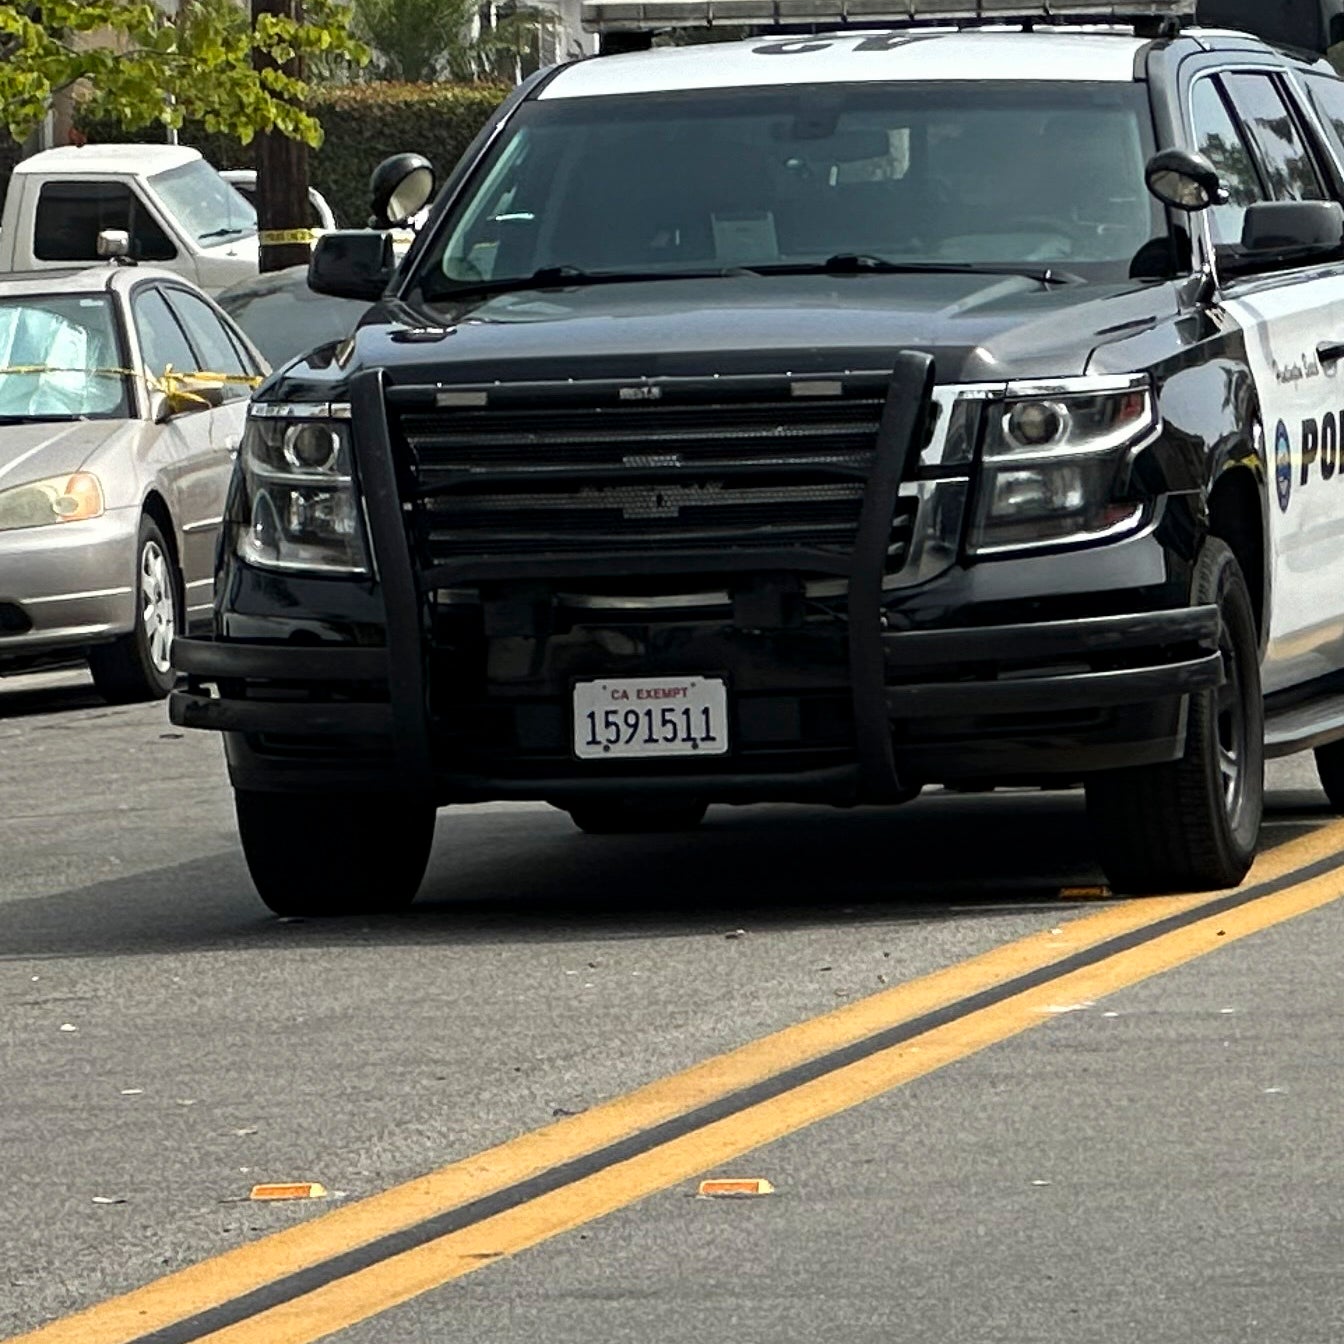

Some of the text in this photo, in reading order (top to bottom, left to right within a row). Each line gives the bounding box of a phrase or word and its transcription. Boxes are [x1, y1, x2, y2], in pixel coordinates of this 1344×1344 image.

[611, 687, 689, 701] CA EXEMPT
[585, 706, 717, 746] 1591511
